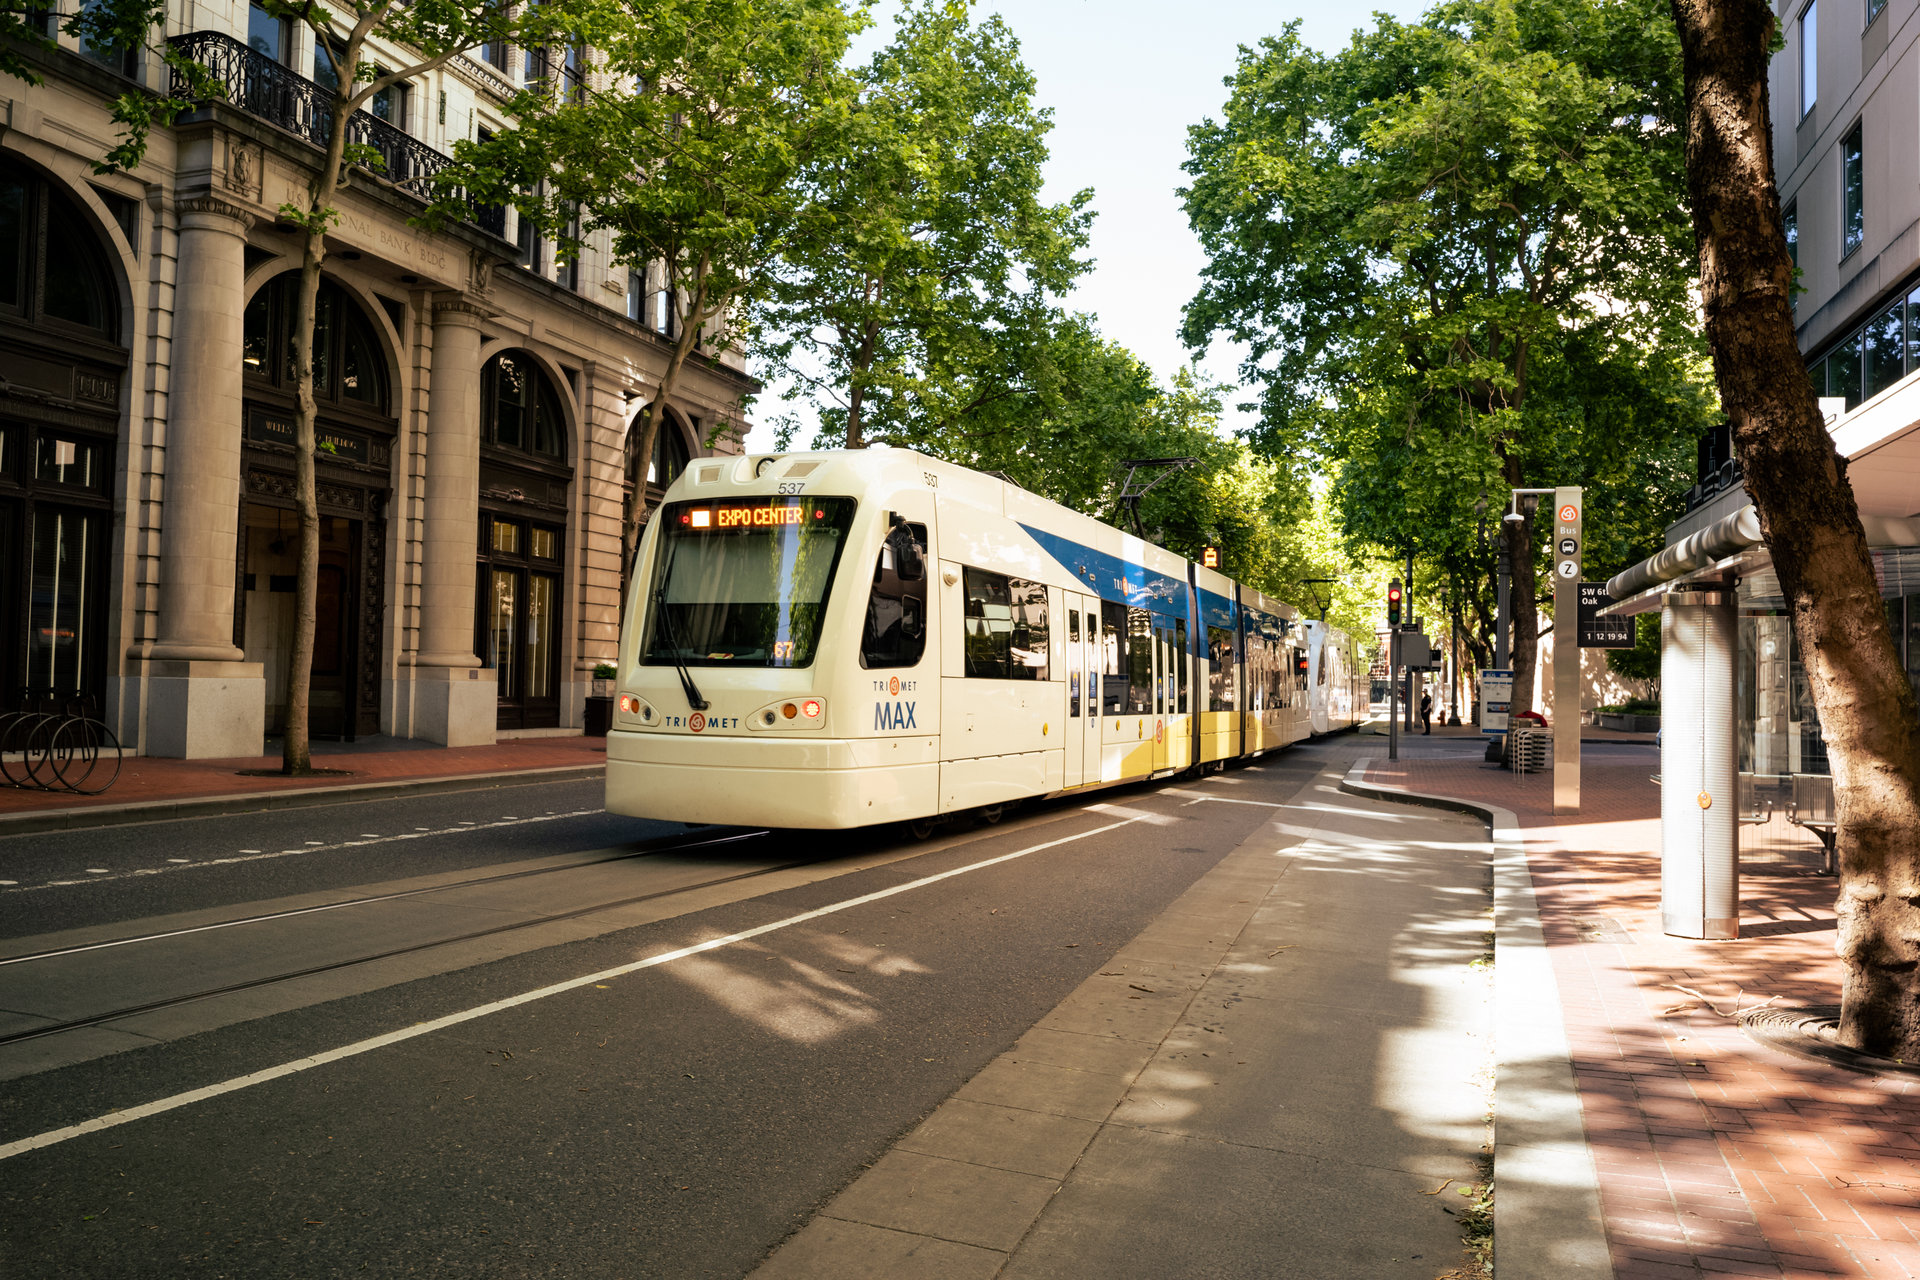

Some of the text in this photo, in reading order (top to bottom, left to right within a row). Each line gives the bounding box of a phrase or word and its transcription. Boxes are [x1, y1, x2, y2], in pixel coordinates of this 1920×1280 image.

[380, 230, 411, 255] BANK
[923, 471, 939, 489] 537
[777, 483, 806, 495] 537
[718, 507, 804, 527] EXPO CENTER
[1560, 526, 1577, 535] Bus
[1564, 563, 1572, 575] Z
[1581, 588, 1595, 596] SW
[1581, 597, 1598, 605] Oak
[774, 641, 793, 658] 67
[874, 701, 917, 731] MAX
